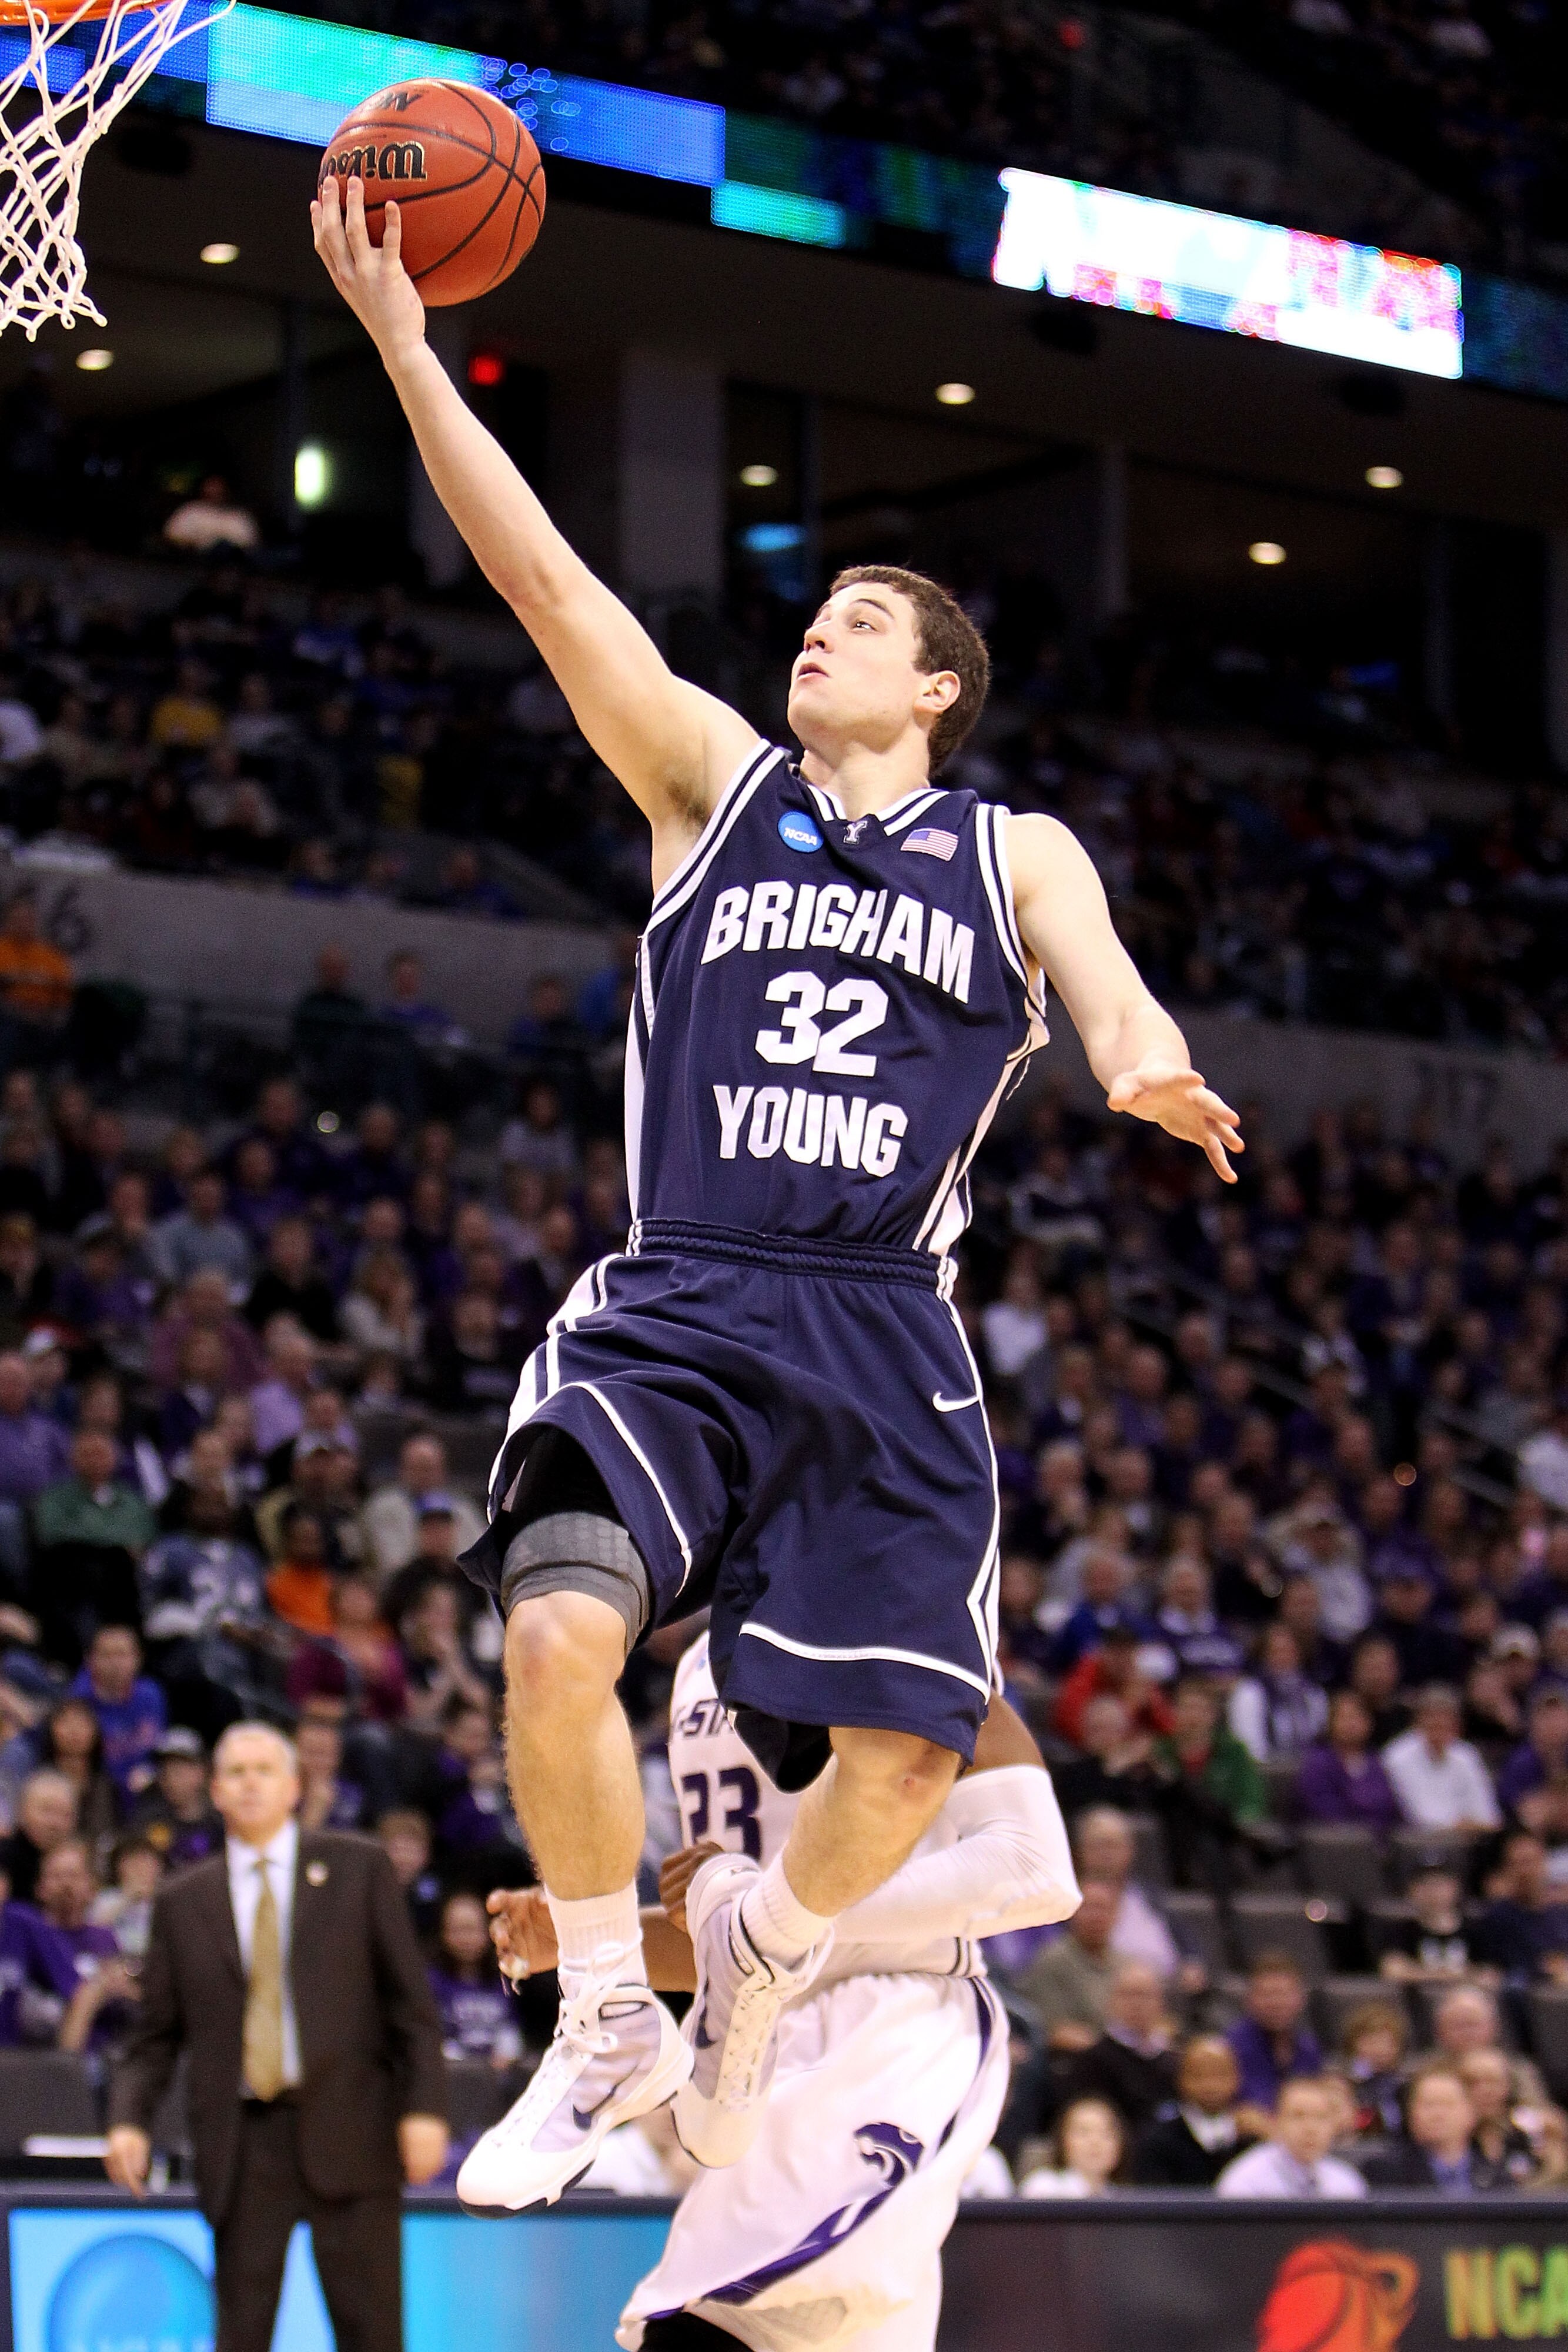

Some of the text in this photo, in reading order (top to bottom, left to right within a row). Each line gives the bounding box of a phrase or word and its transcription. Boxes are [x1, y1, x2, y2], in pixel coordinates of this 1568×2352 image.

[318, 141, 427, 188] Wilso
[783, 827, 818, 846] NCAA
[843, 820, 868, 845] Y
[701, 880, 975, 1004] BRIGHAM
[755, 971, 888, 1077] 32
[713, 1085, 908, 1177] YOUNG
